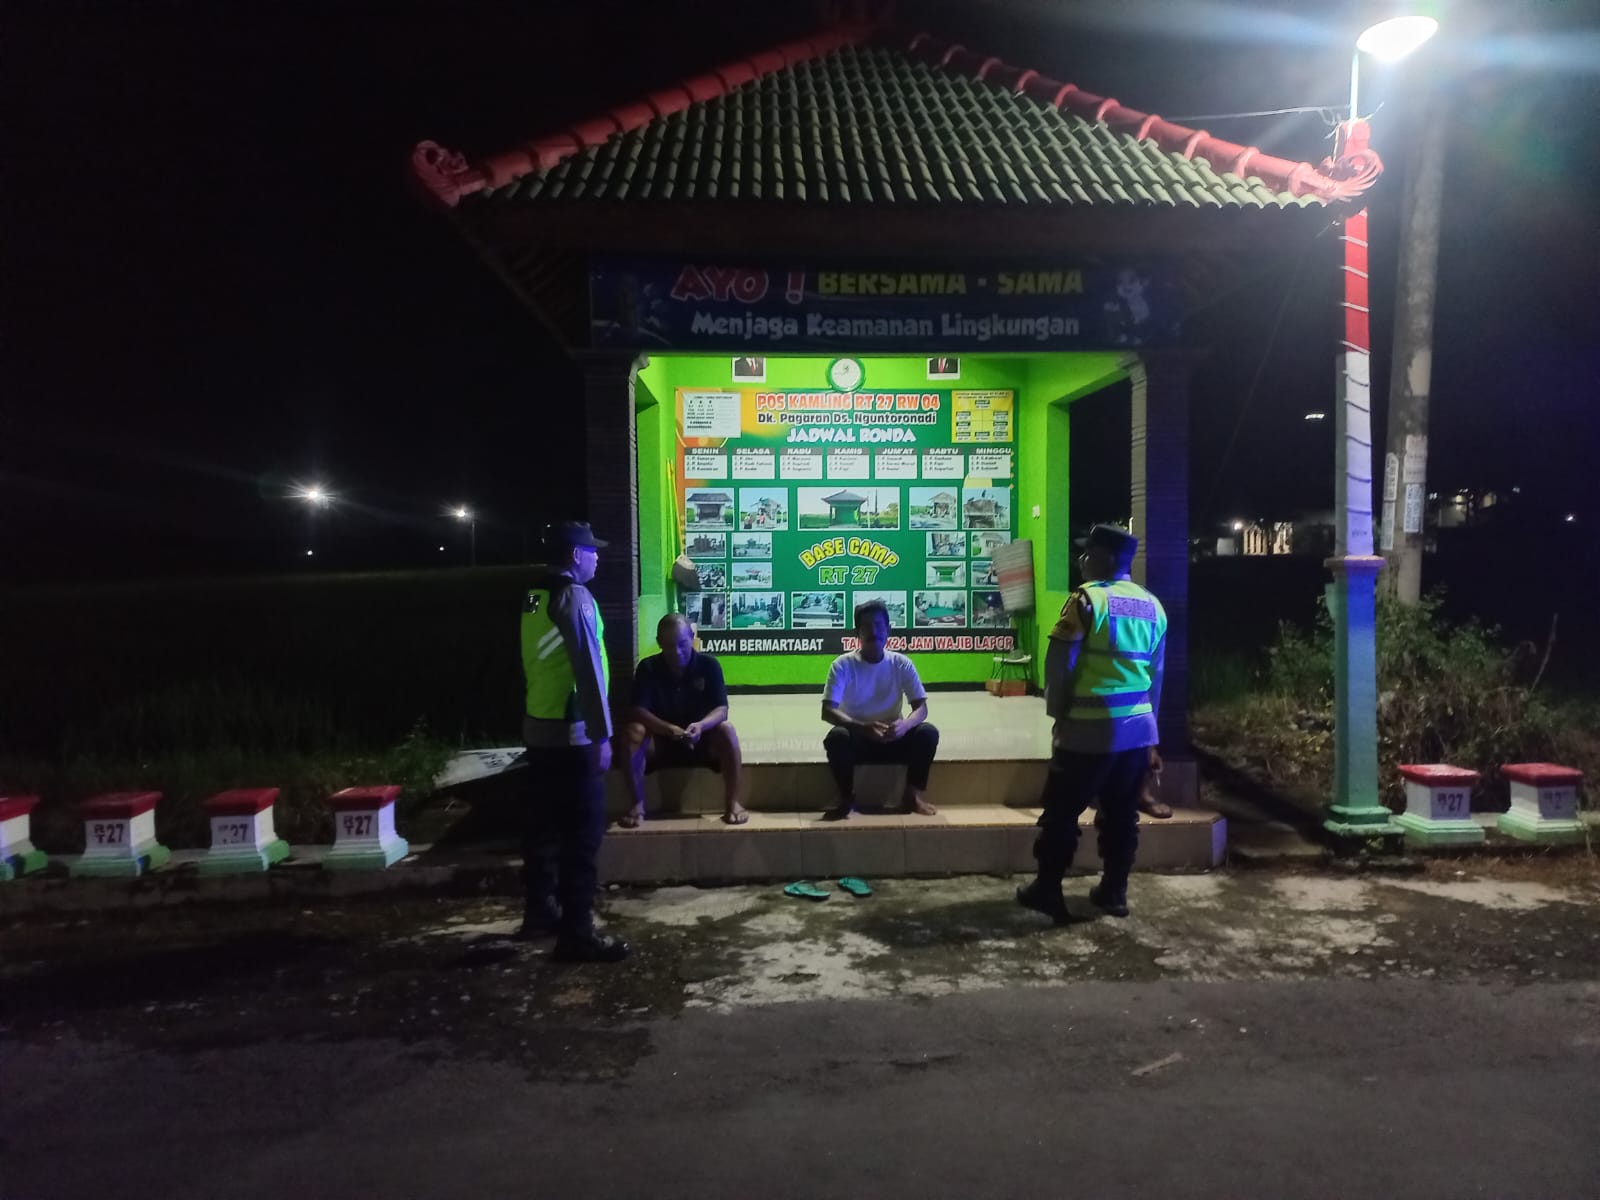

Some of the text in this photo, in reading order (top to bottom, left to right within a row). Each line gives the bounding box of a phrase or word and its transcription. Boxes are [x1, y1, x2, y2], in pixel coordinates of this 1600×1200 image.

[671, 264, 769, 303] AYO
[816, 272, 967, 295] BERSAMA
[997, 270, 1084, 295] SAMA
[691, 310, 1080, 342] Menjaga Keamanan Lingkungan
[756, 392, 940, 411] POS KAMLING RT 27 RW 04
[758, 412, 937, 425] Dk. Pagaran Ds. Nguntoronadi
[786, 427, 917, 443] JADWAL RONDA
[799, 537, 901, 569] BASE CAMP
[819, 566, 879, 585] RT 27
[699, 638, 824, 652] LAYAH BERMARTABAT
[841, 637, 862, 651] TA
[908, 635, 934, 650] JAM
[934, 635, 974, 650] WAJIB
[974, 635, 1014, 650] LAPOR
[1448, 793, 1464, 812] 27
[105, 823, 125, 844] 27
[231, 823, 249, 844] 27
[355, 815, 373, 835] 27
